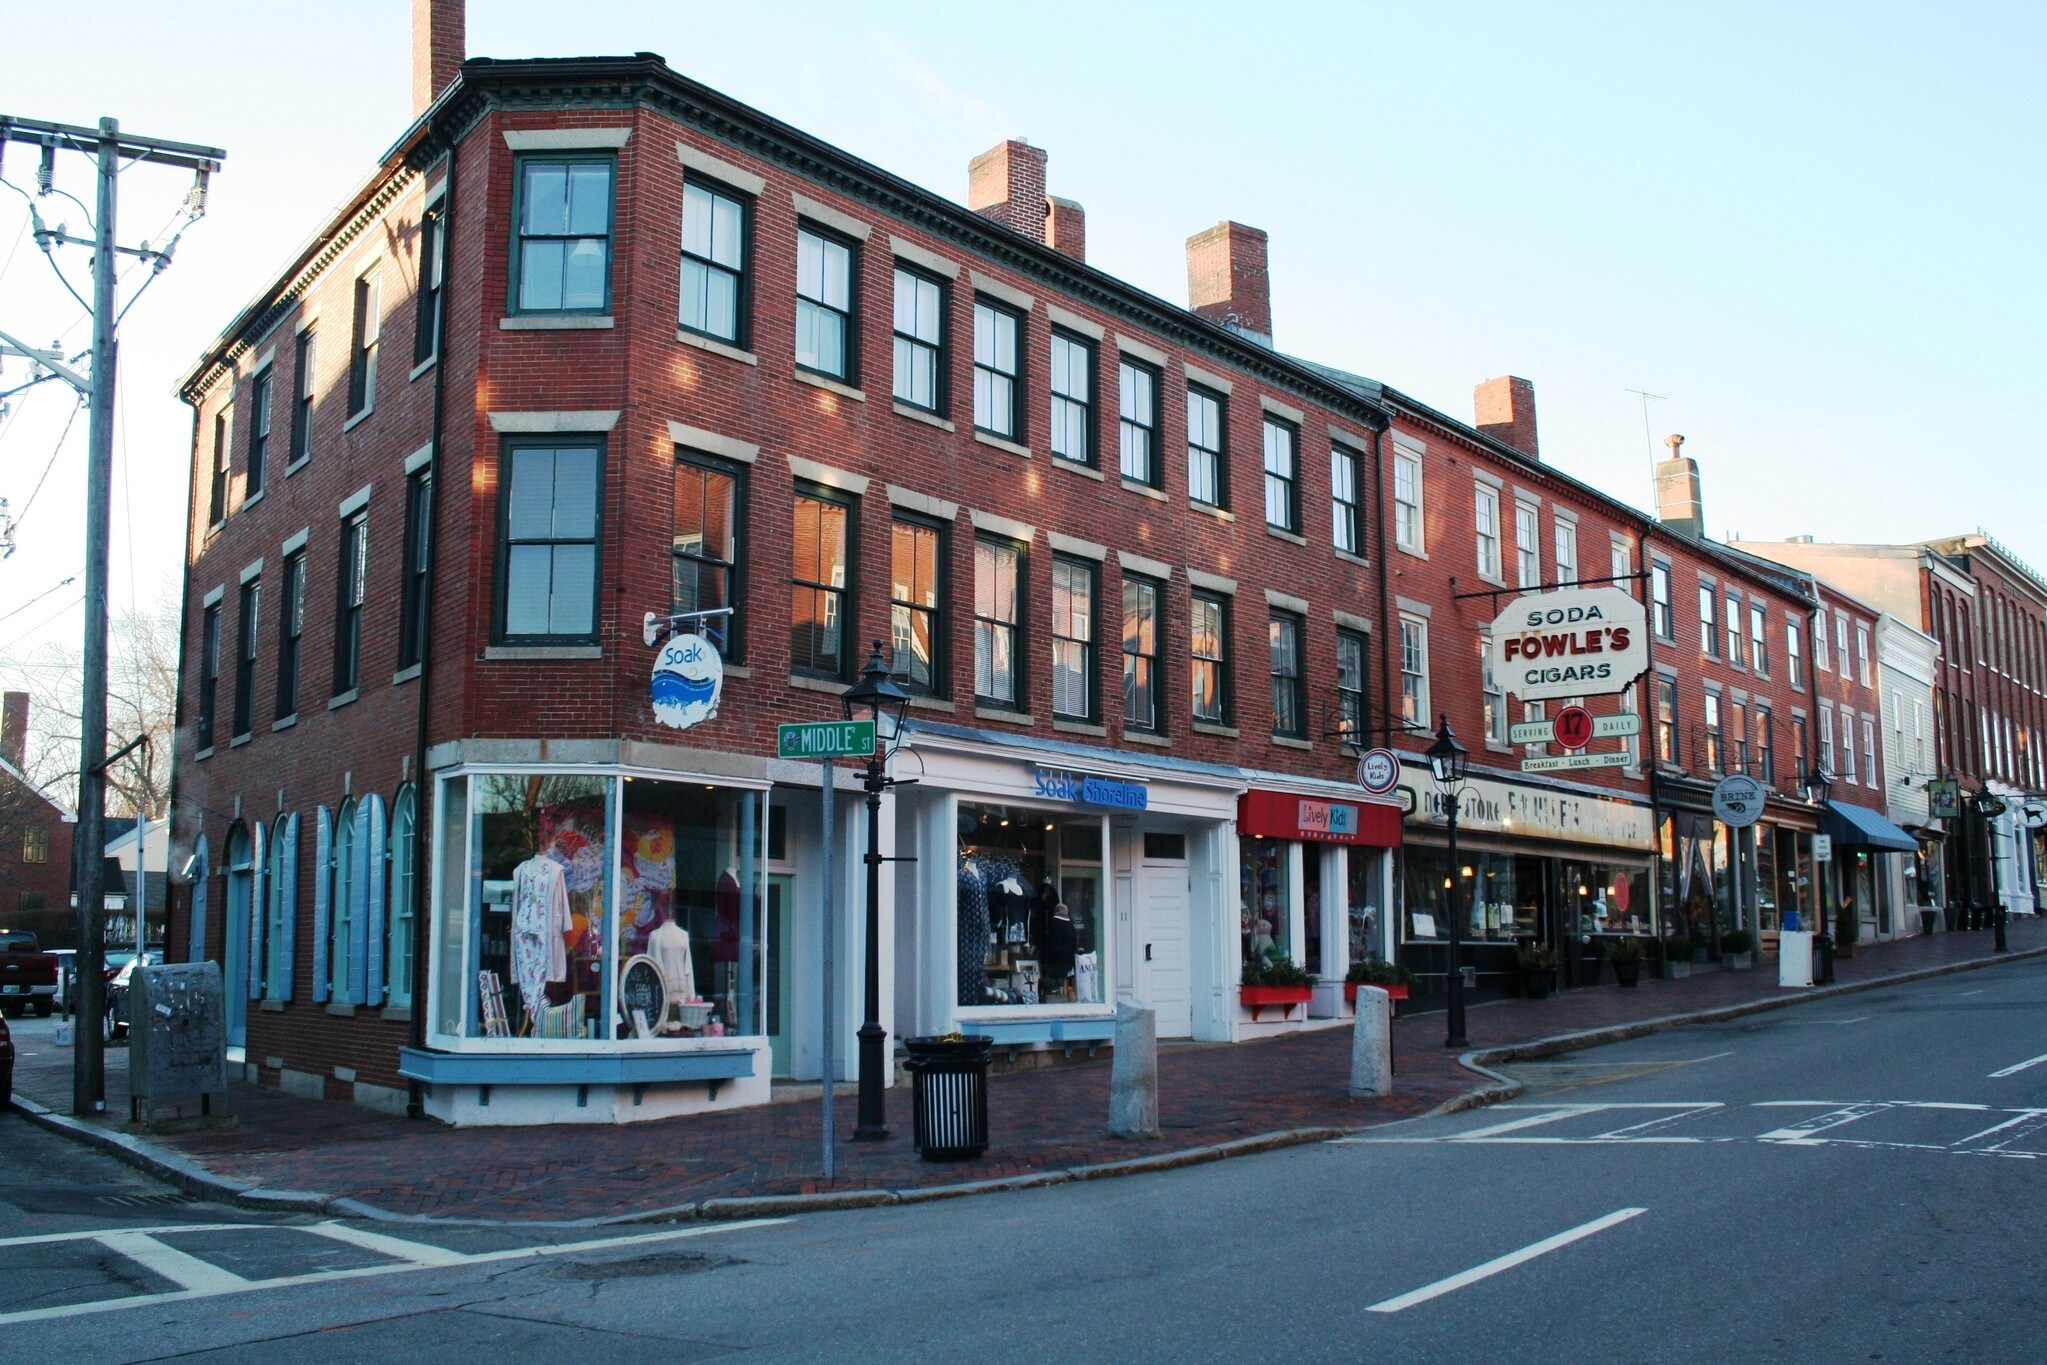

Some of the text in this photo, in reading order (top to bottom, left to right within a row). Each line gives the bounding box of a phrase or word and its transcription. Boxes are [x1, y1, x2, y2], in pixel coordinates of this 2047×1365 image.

[1527, 605, 1603, 627] SODA
[665, 643, 702, 665] Soak
[1504, 627, 1631, 662] FOWLE'S
[1525, 663, 1611, 684] CIGARS
[1513, 727, 1548, 739] SERVING
[1563, 712, 1584, 735] 17
[1603, 721, 1632, 731] DAILY
[801, 726, 871, 752] MIDDLE ST
[1524, 755, 1627, 770] Breakfast Lunch Dinner
[1369, 771, 1385, 780] Kids
[1035, 769, 1144, 807] Soak Shoreline
[1720, 791, 1756, 802] BRINE
[1303, 804, 1328, 828] Lively
